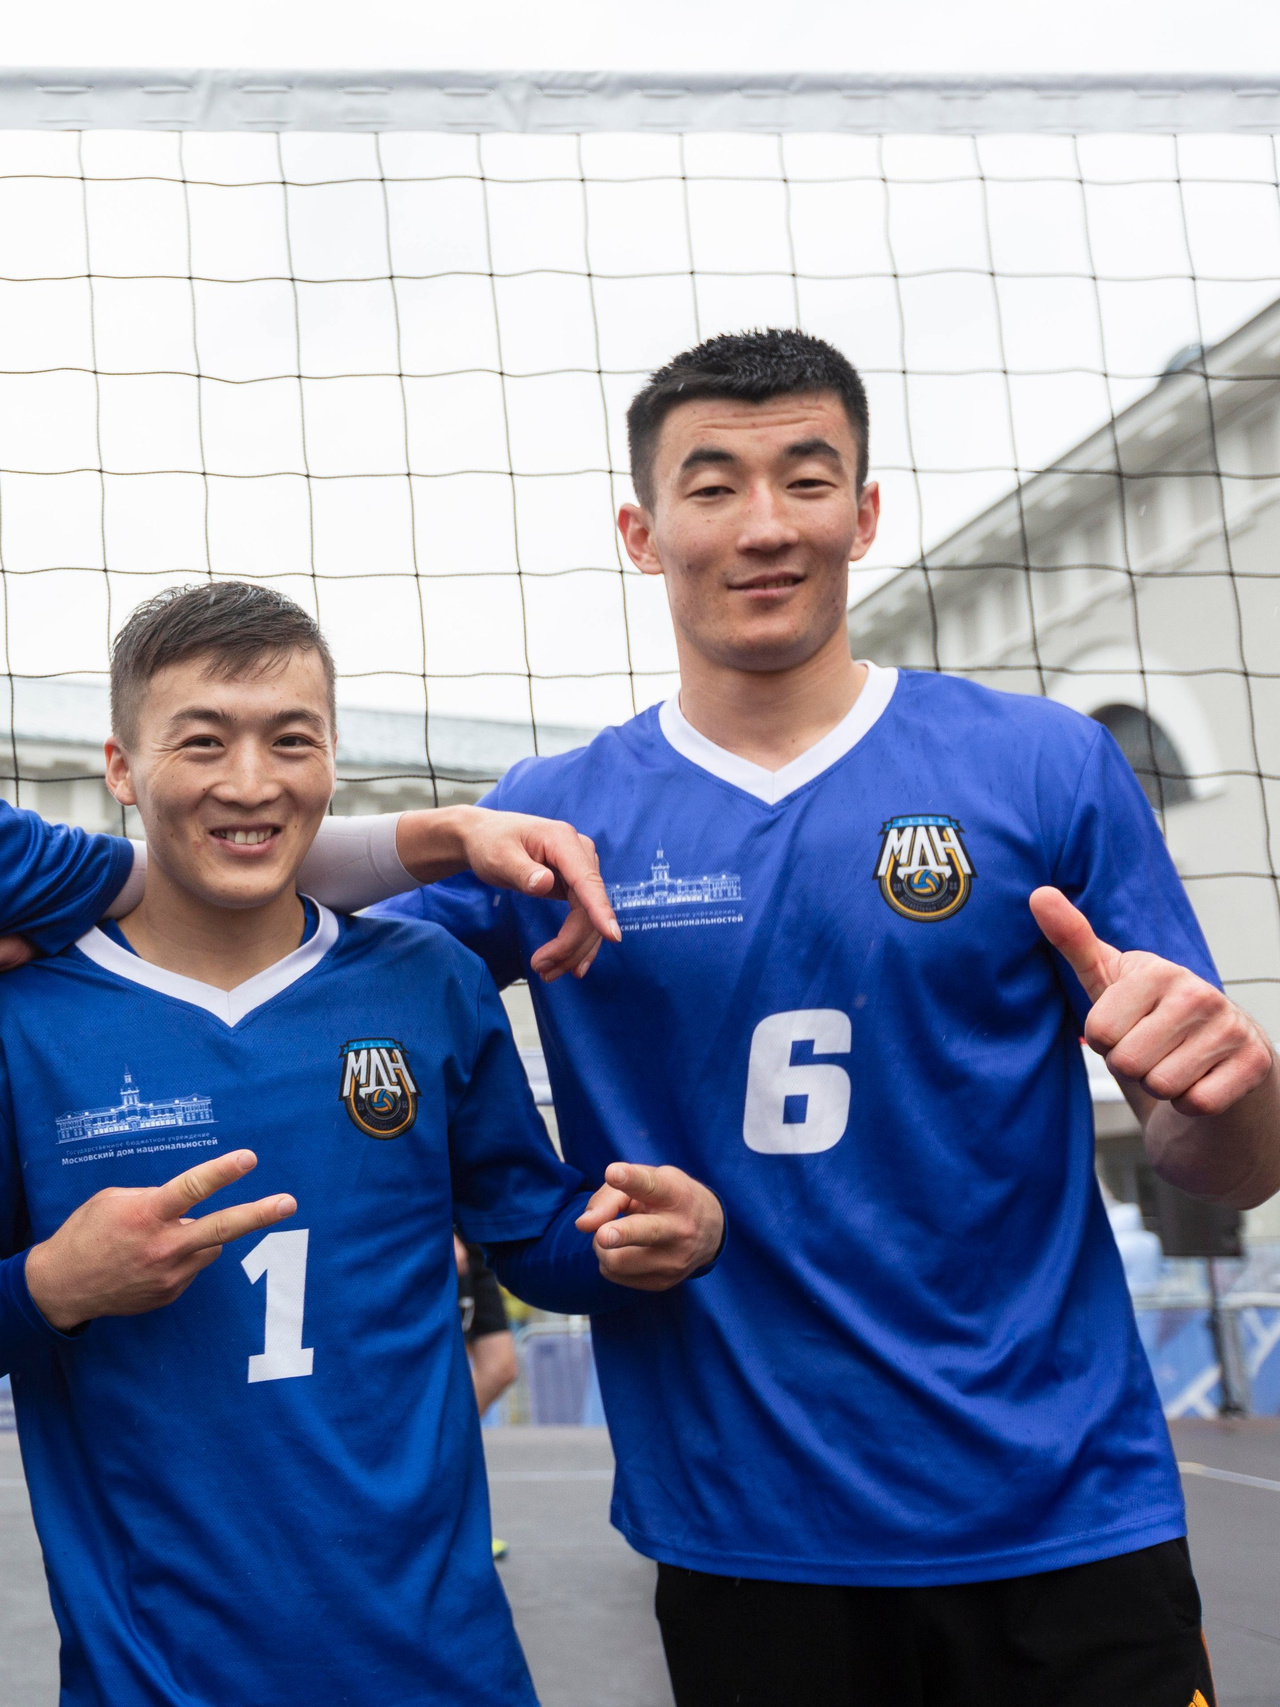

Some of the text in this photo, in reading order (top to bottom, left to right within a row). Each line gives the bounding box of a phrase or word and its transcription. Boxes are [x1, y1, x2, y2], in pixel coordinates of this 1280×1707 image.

[878, 826, 972, 880] МДН
[641, 922, 659, 931] дом
[660, 913, 743, 928] национальностей
[343, 1048, 417, 1099] МДН
[743, 1008, 852, 1154] 6
[61, 1136, 218, 1166] Московский дом национальностей
[240, 1228, 314, 1383] 1
